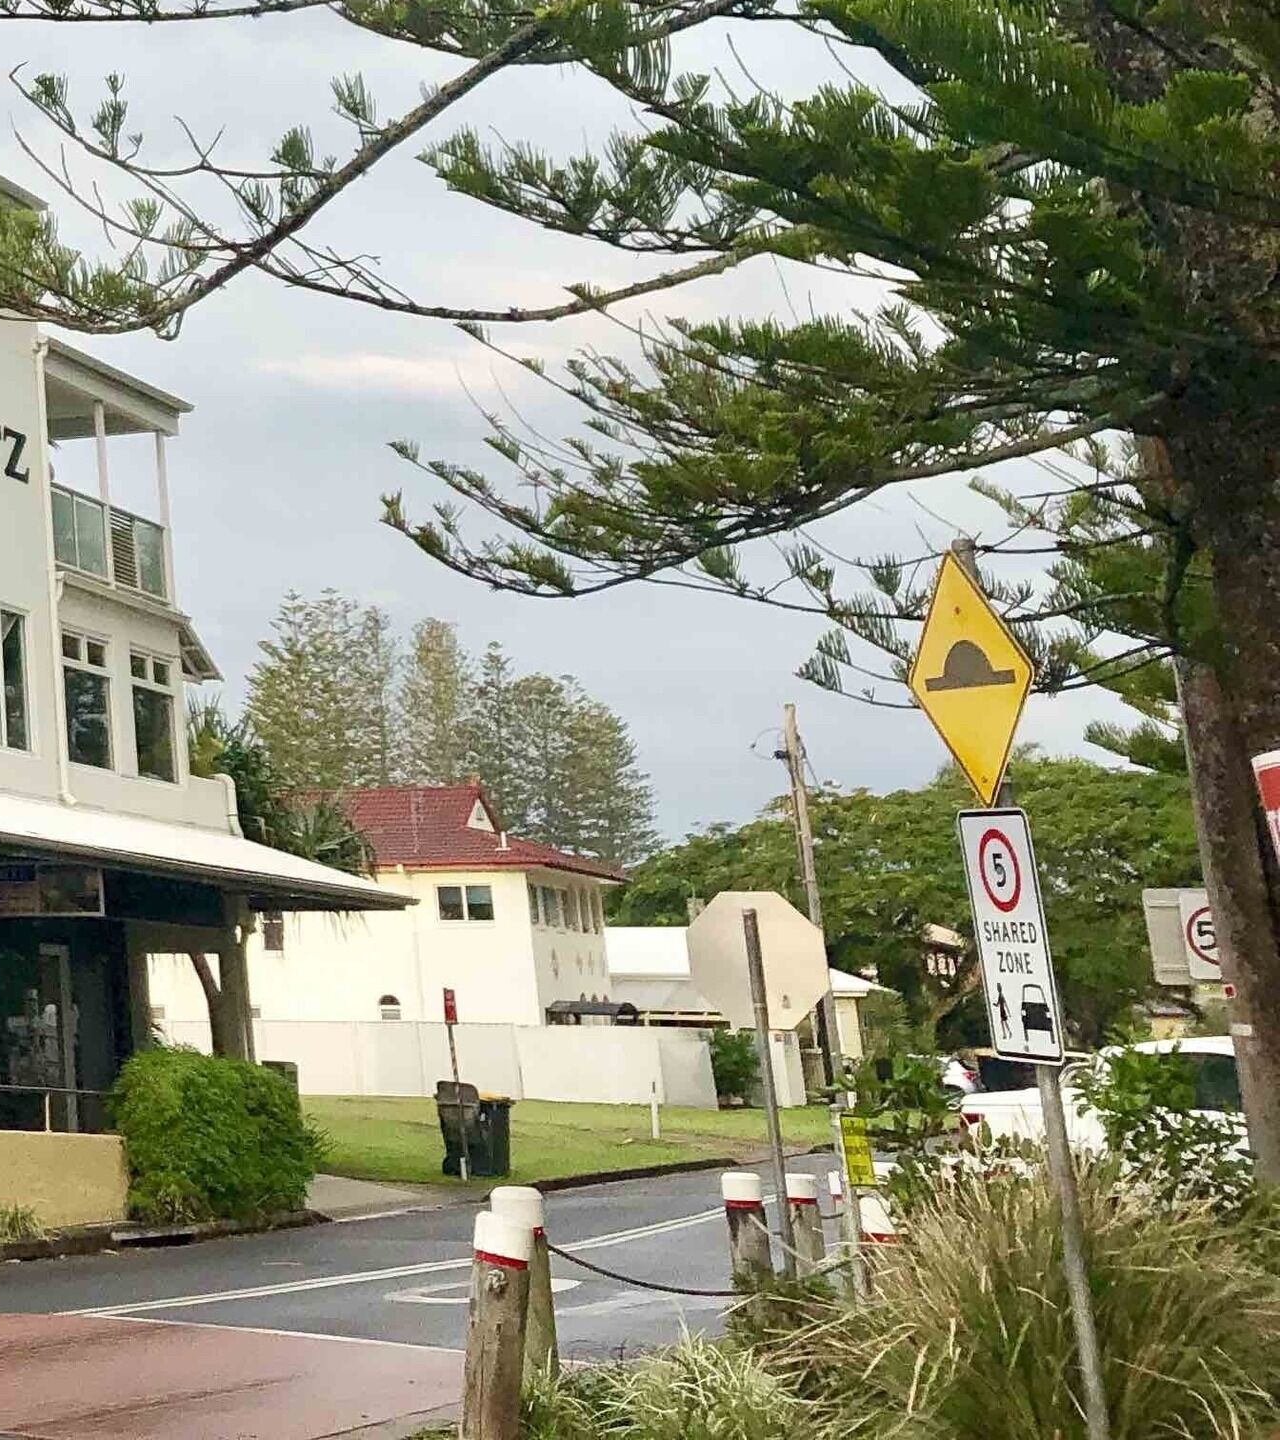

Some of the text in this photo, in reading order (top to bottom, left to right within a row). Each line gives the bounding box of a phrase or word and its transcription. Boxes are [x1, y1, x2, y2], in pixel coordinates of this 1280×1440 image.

[991, 852, 1007, 888] 5
[983, 920, 1037, 944] SHARED
[997, 951, 1033, 974] ZONE
